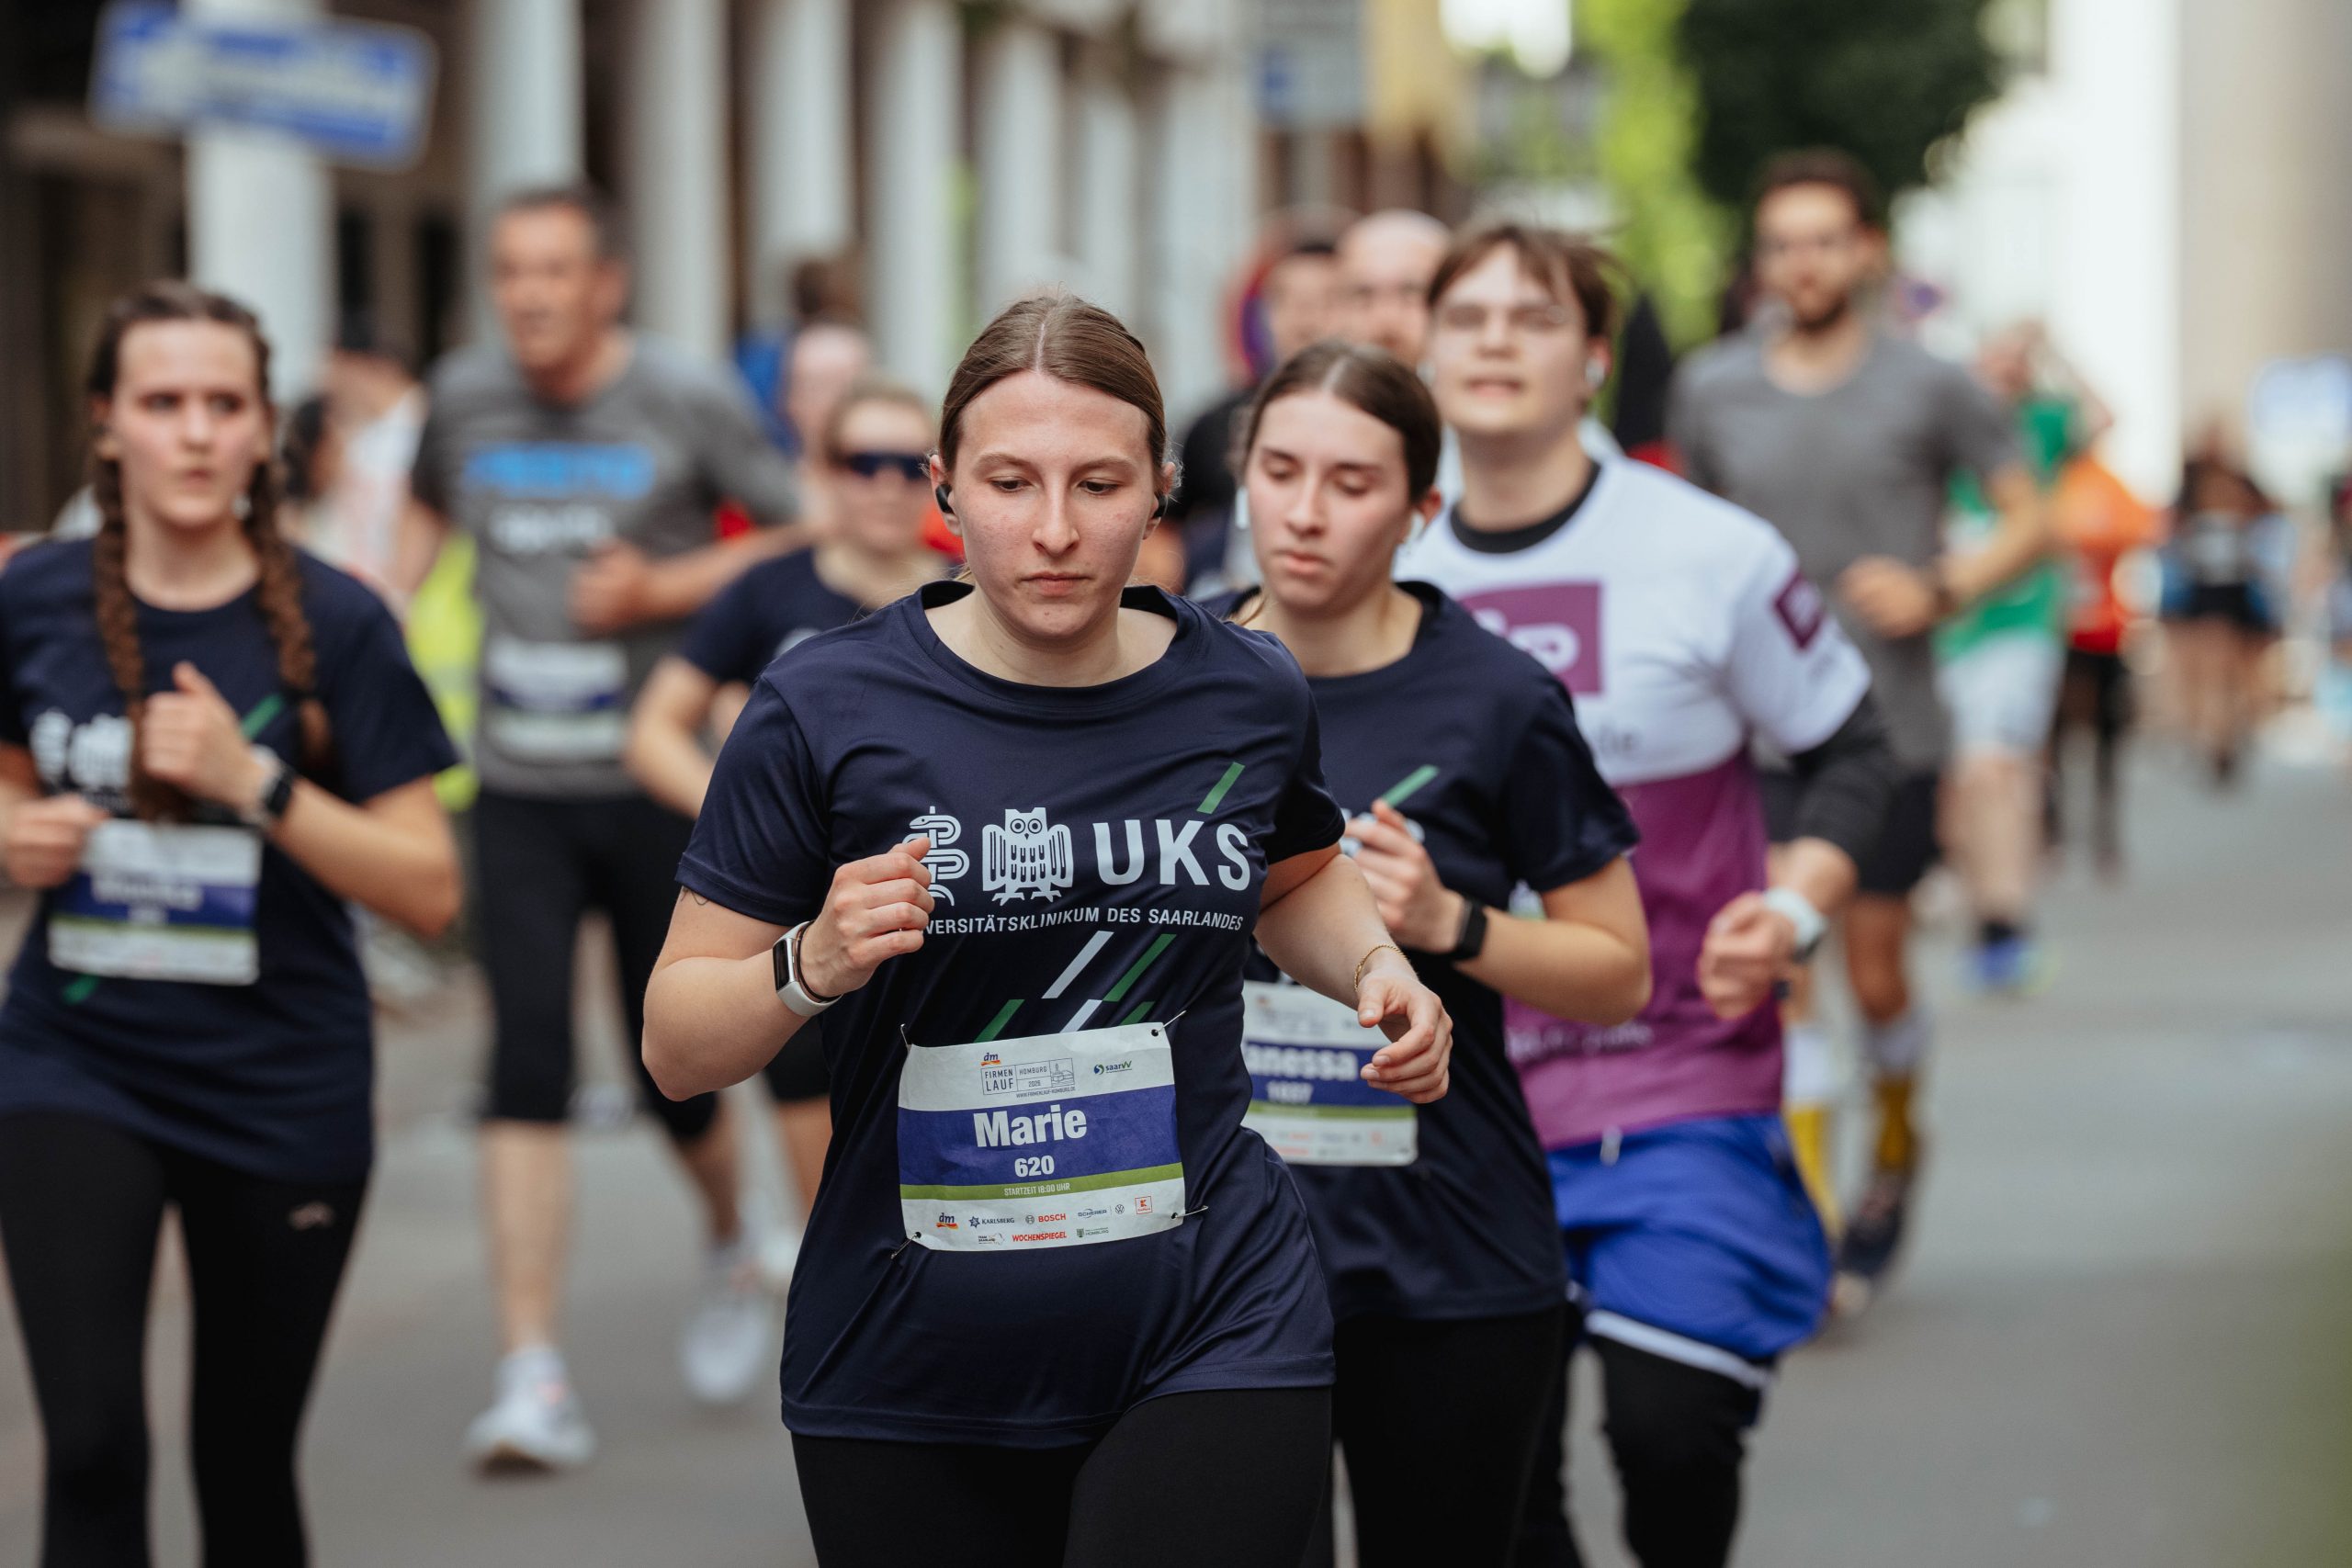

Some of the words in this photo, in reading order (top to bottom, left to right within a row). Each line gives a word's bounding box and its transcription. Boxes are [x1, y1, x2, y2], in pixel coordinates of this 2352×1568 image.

[1092, 818, 1251, 892] UKS
[924, 907, 1100, 935] VERSITÄTSKLINIKUM
[1107, 908, 1141, 924] DES
[1148, 908, 1244, 931] SAARLANDES
[983, 1052, 999, 1062] dm
[1242, 1044, 1358, 1081] anessa
[985, 1068, 1013, 1079] FIRMEN
[1019, 1066, 1047, 1076] HOMBURG
[986, 1078, 1013, 1091] LAUF
[973, 1104, 1087, 1147] Marie
[1014, 1155, 1055, 1177] 620
[1003, 1185, 1037, 1196] STARTZEIT
[1037, 1183, 1056, 1194] 18:00
[1056, 1182, 1070, 1191] UHR
[939, 1213, 955, 1224] dm
[1038, 1213, 1067, 1223] BOSCH
[1012, 1231, 1068, 1242] WOCHENSPIEGEL
